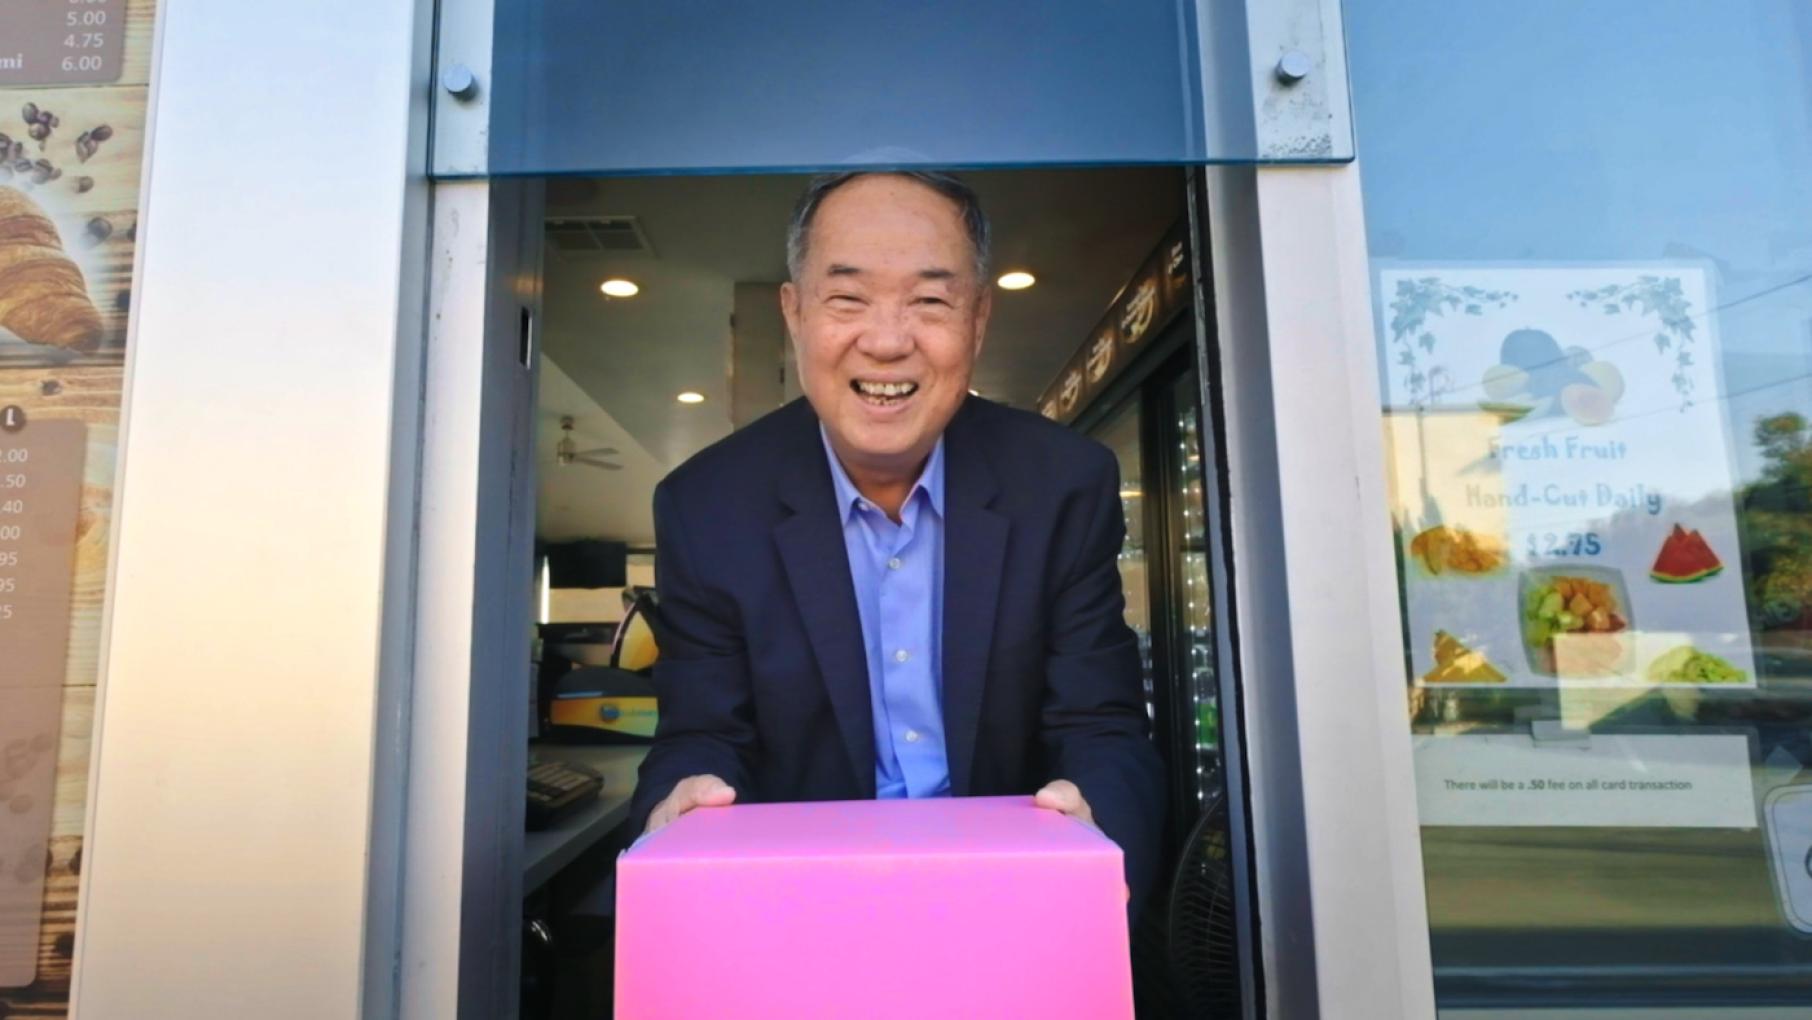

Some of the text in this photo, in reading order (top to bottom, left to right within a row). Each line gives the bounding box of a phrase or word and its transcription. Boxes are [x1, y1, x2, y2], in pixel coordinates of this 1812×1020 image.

[66, 10, 106, 26] 5.00
[63, 33, 104, 48] 4.75
[61, 56, 103, 71] 6.00
[1487, 435, 1627, 460] Fresh Fruit
[1465, 483, 1662, 516] Hand-Cut Daily
[1526, 532, 1601, 556] $2.75
[1444, 779, 1693, 791] There will be a .50 fee on all card transaction
